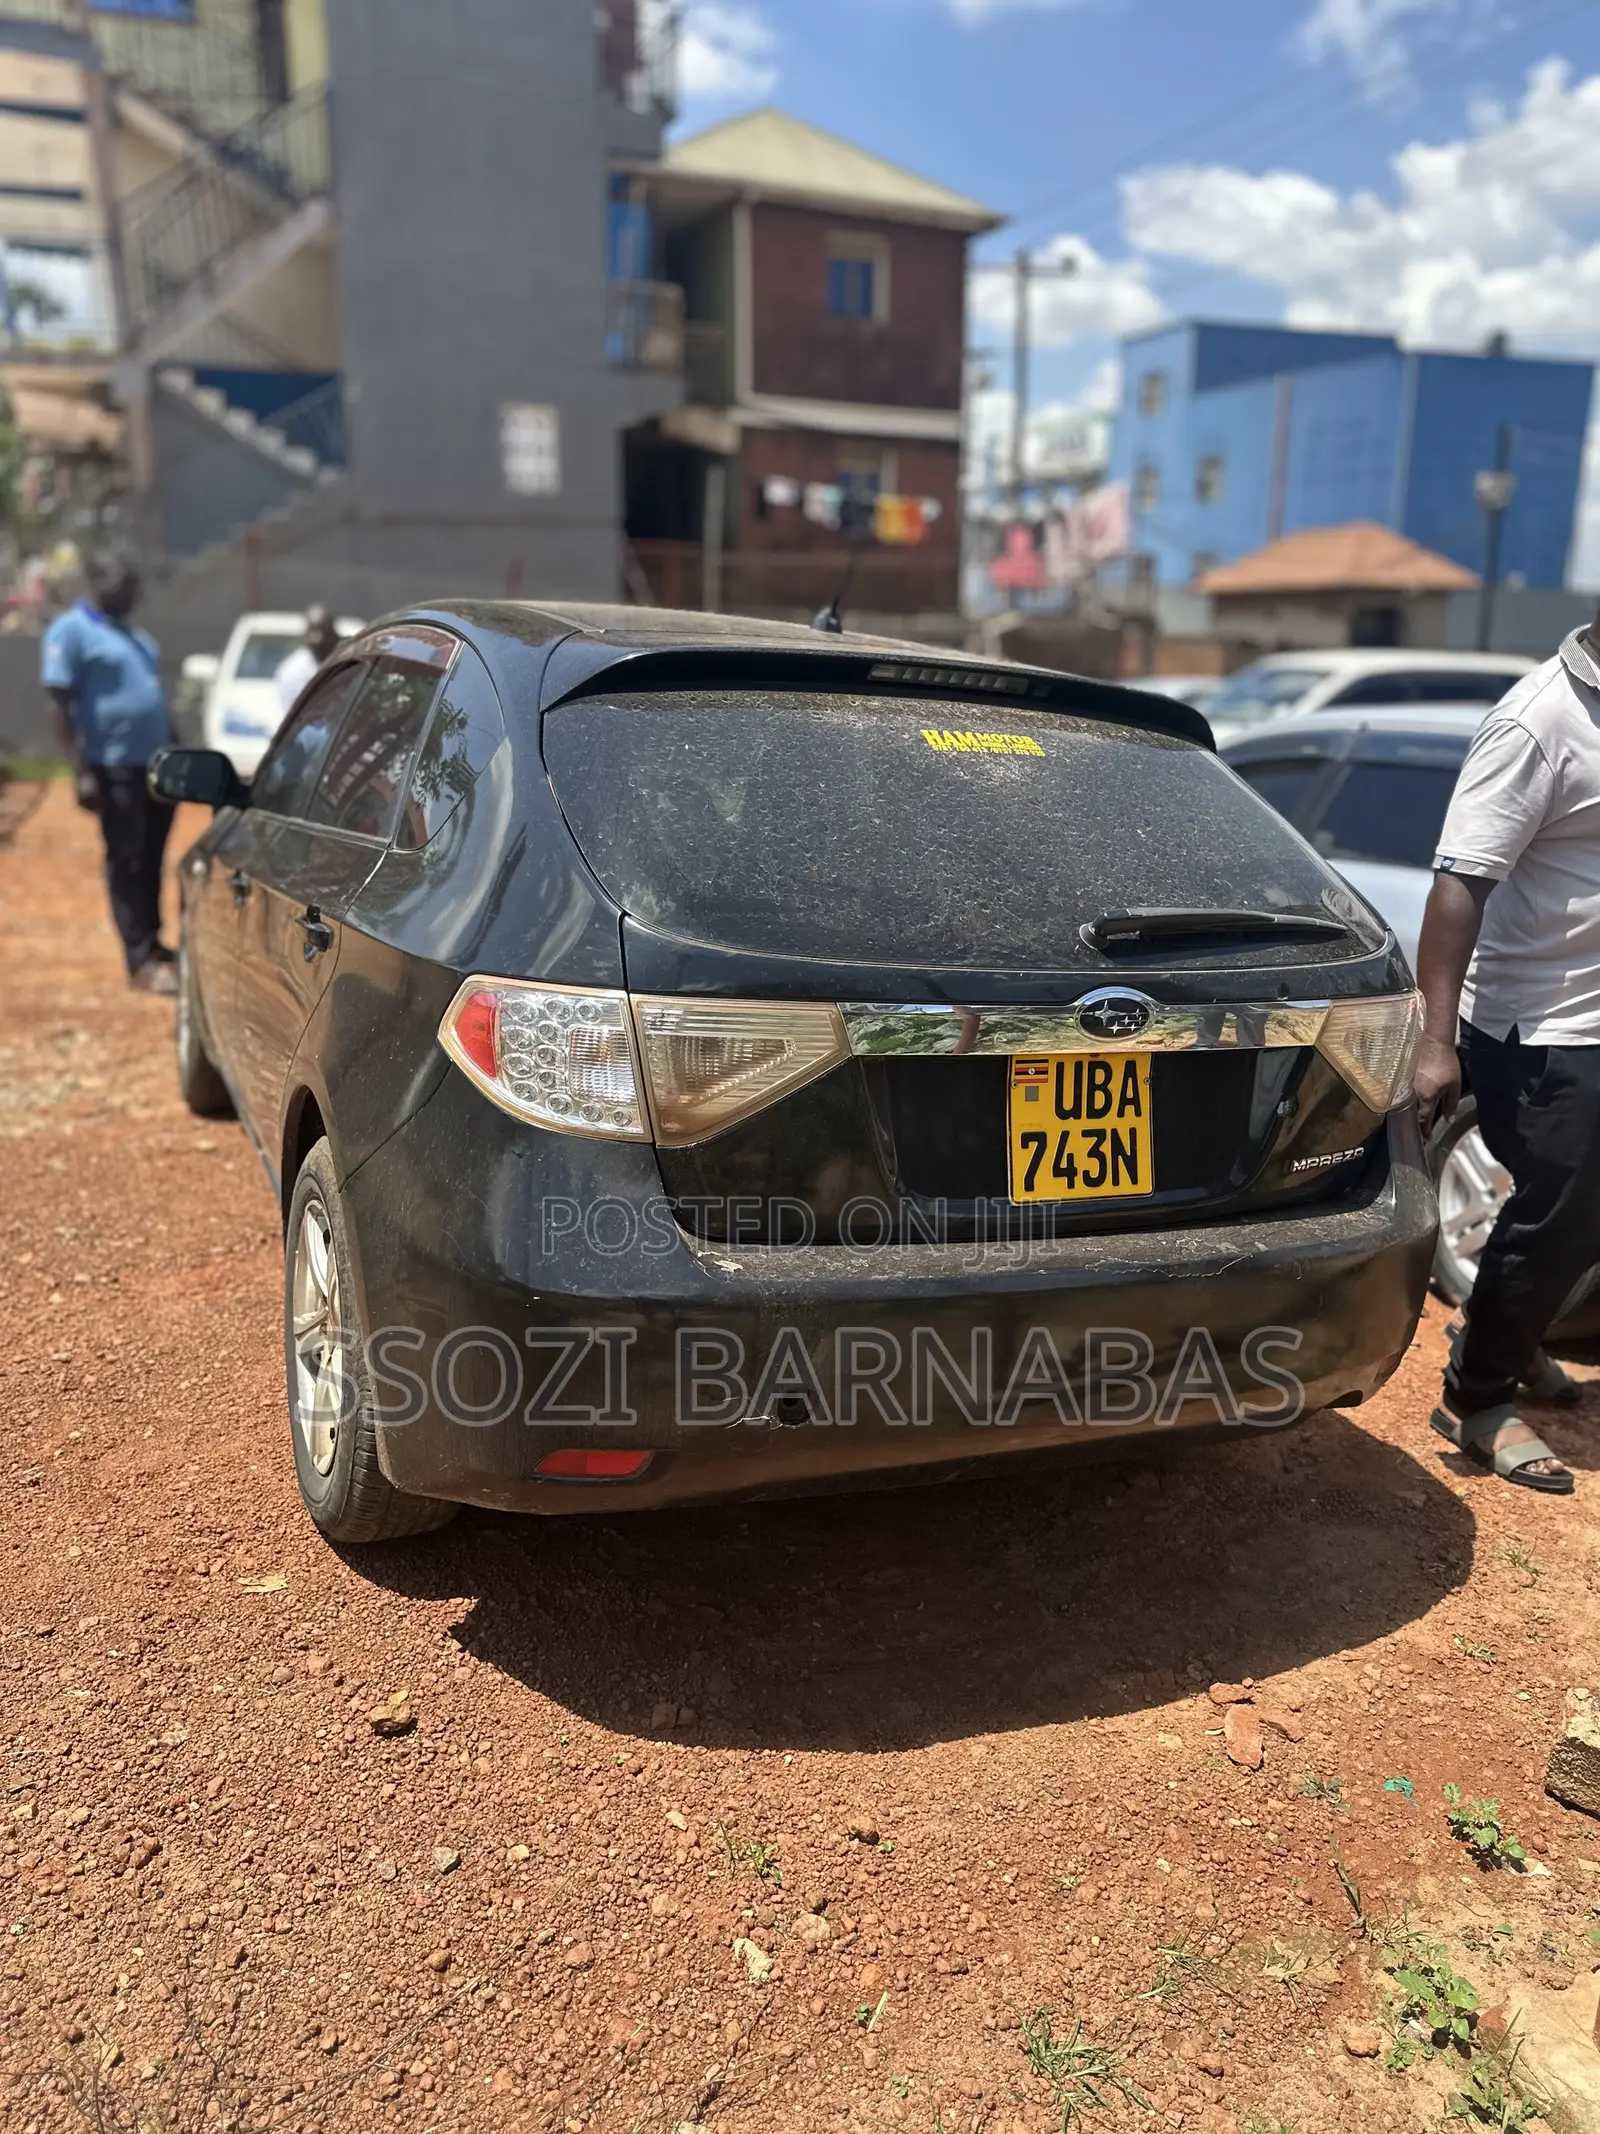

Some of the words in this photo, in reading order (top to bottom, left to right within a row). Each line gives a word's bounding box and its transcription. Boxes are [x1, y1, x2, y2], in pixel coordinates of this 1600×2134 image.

[920, 729, 981, 748] HAM
[974, 732, 1035, 745] MOTOR
[1054, 1059, 1142, 1120] UBA
[1021, 1127, 1138, 1192] 743N
